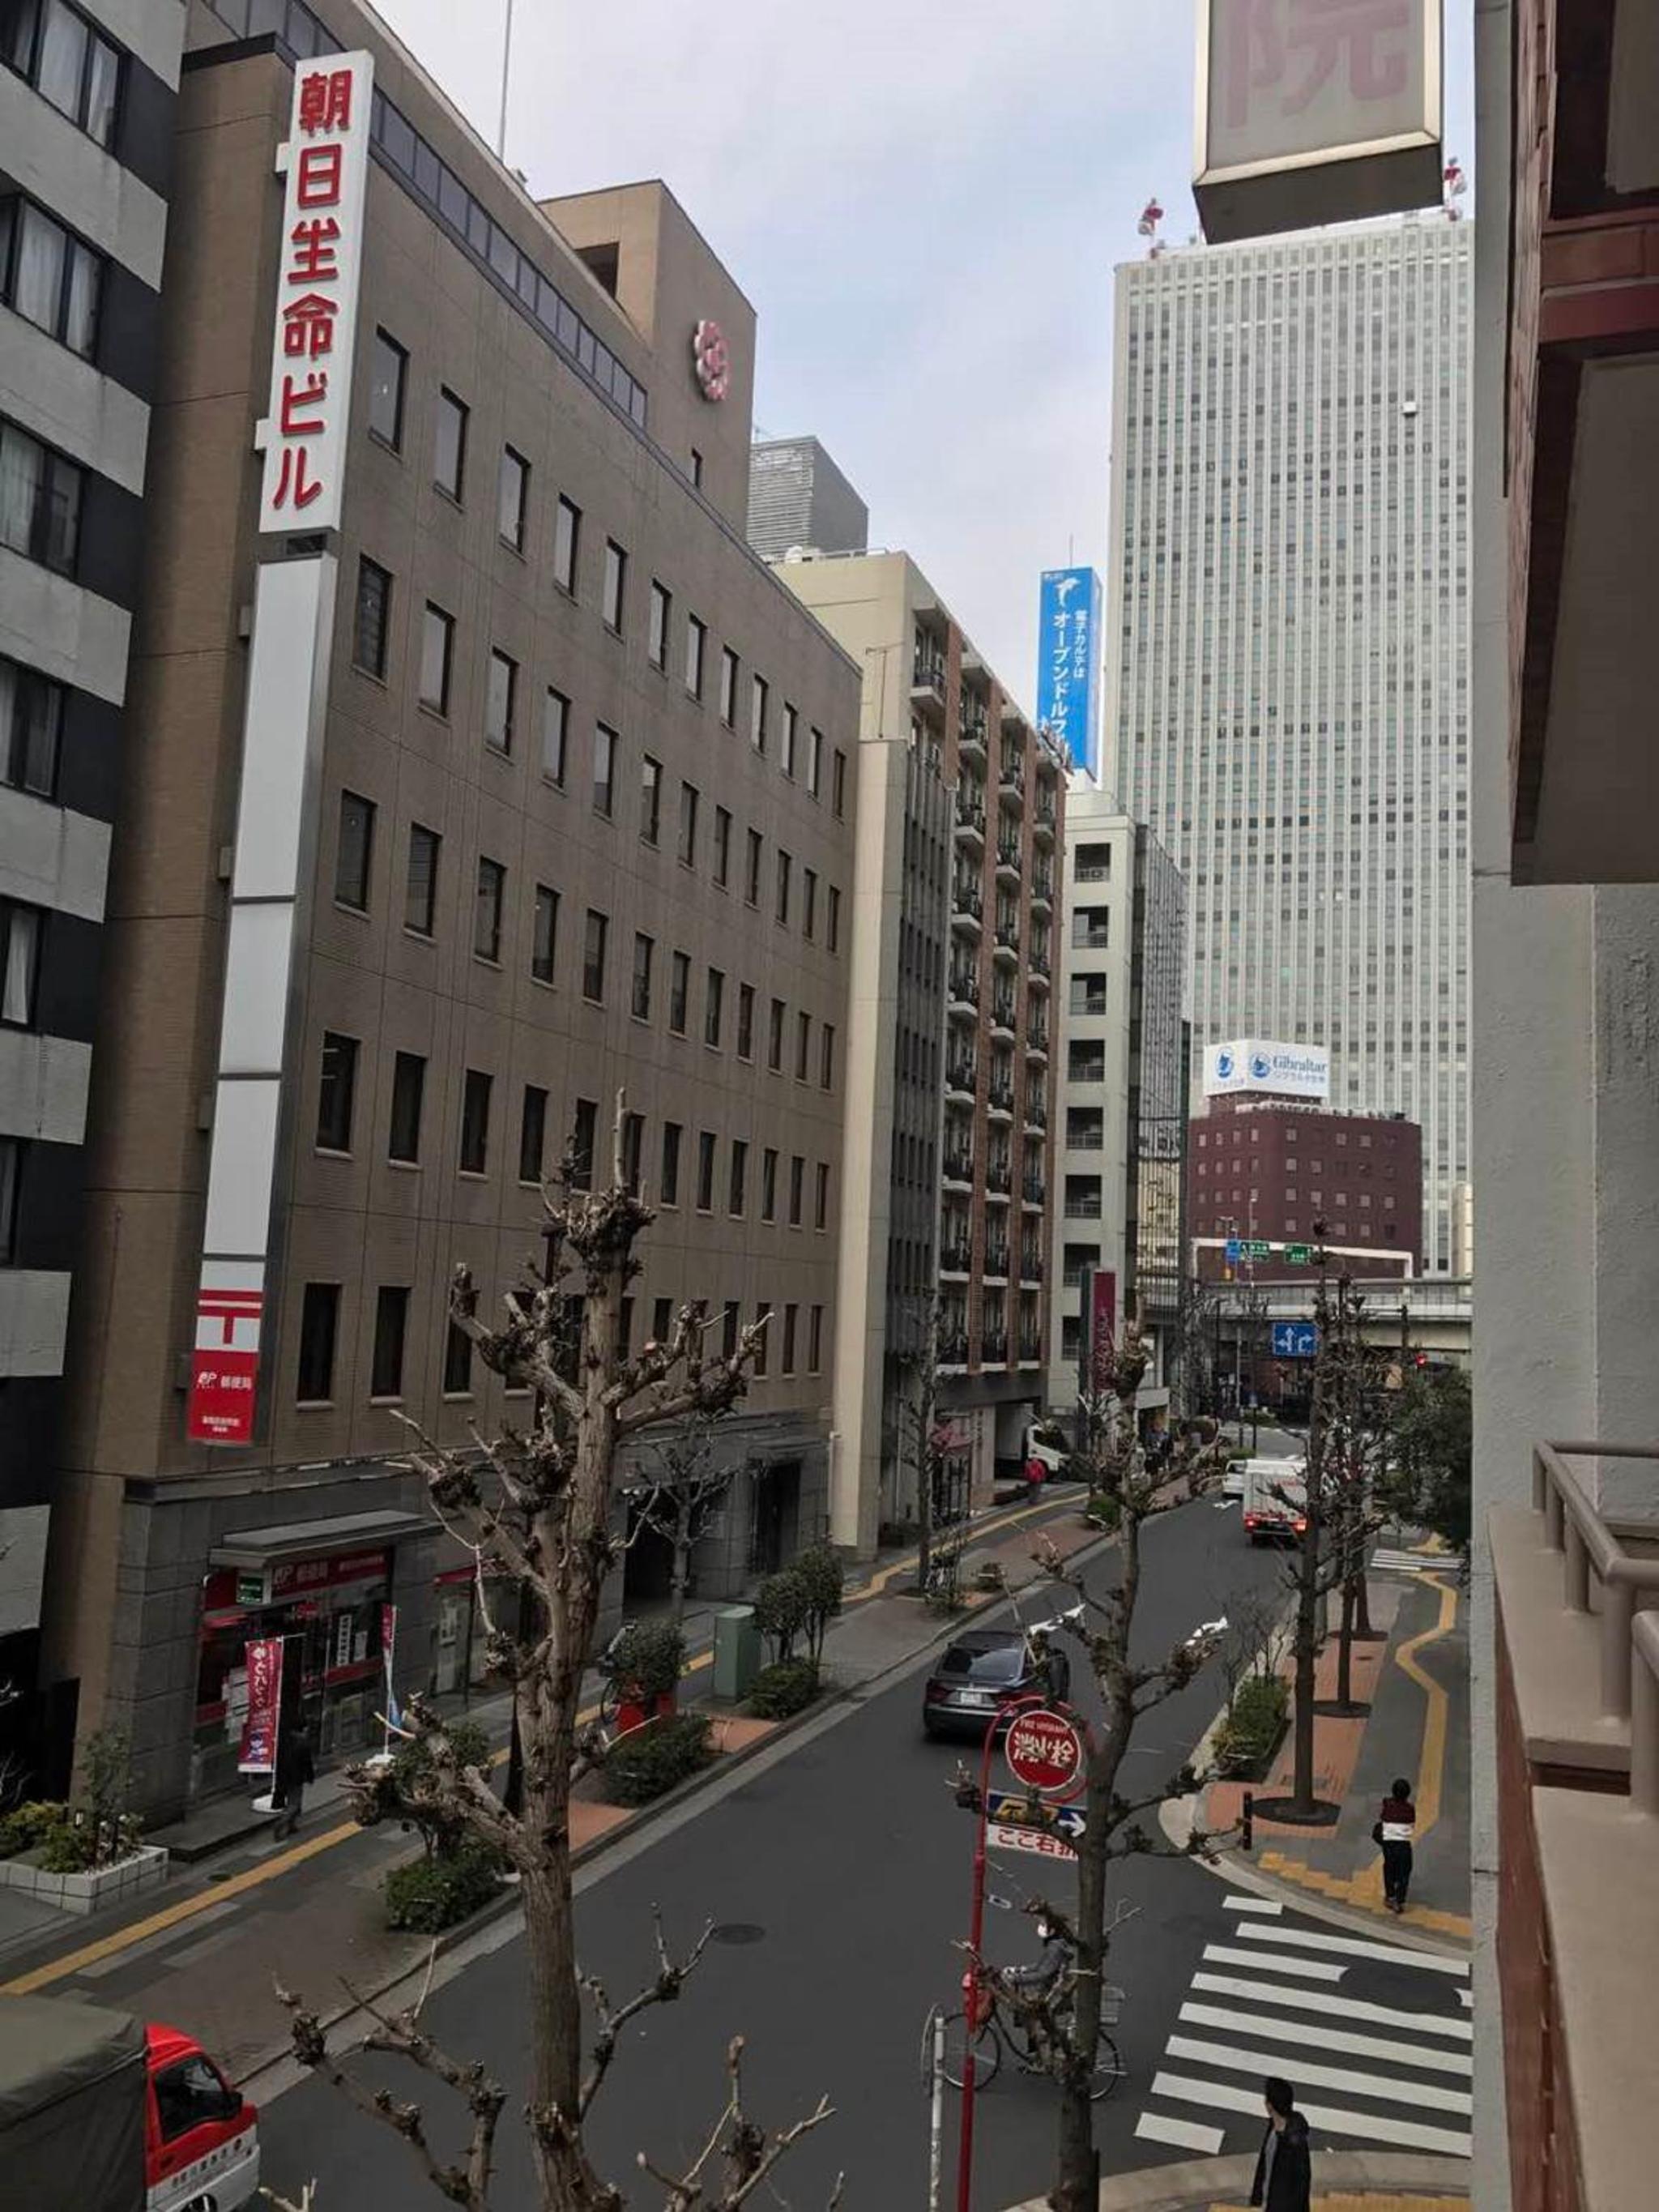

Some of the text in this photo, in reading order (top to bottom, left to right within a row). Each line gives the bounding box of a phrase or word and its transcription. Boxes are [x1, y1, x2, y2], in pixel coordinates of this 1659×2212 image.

[273, 69, 353, 509] 朝日生命ビル
[1273, 1056, 1326, 1072] Gibraltar
